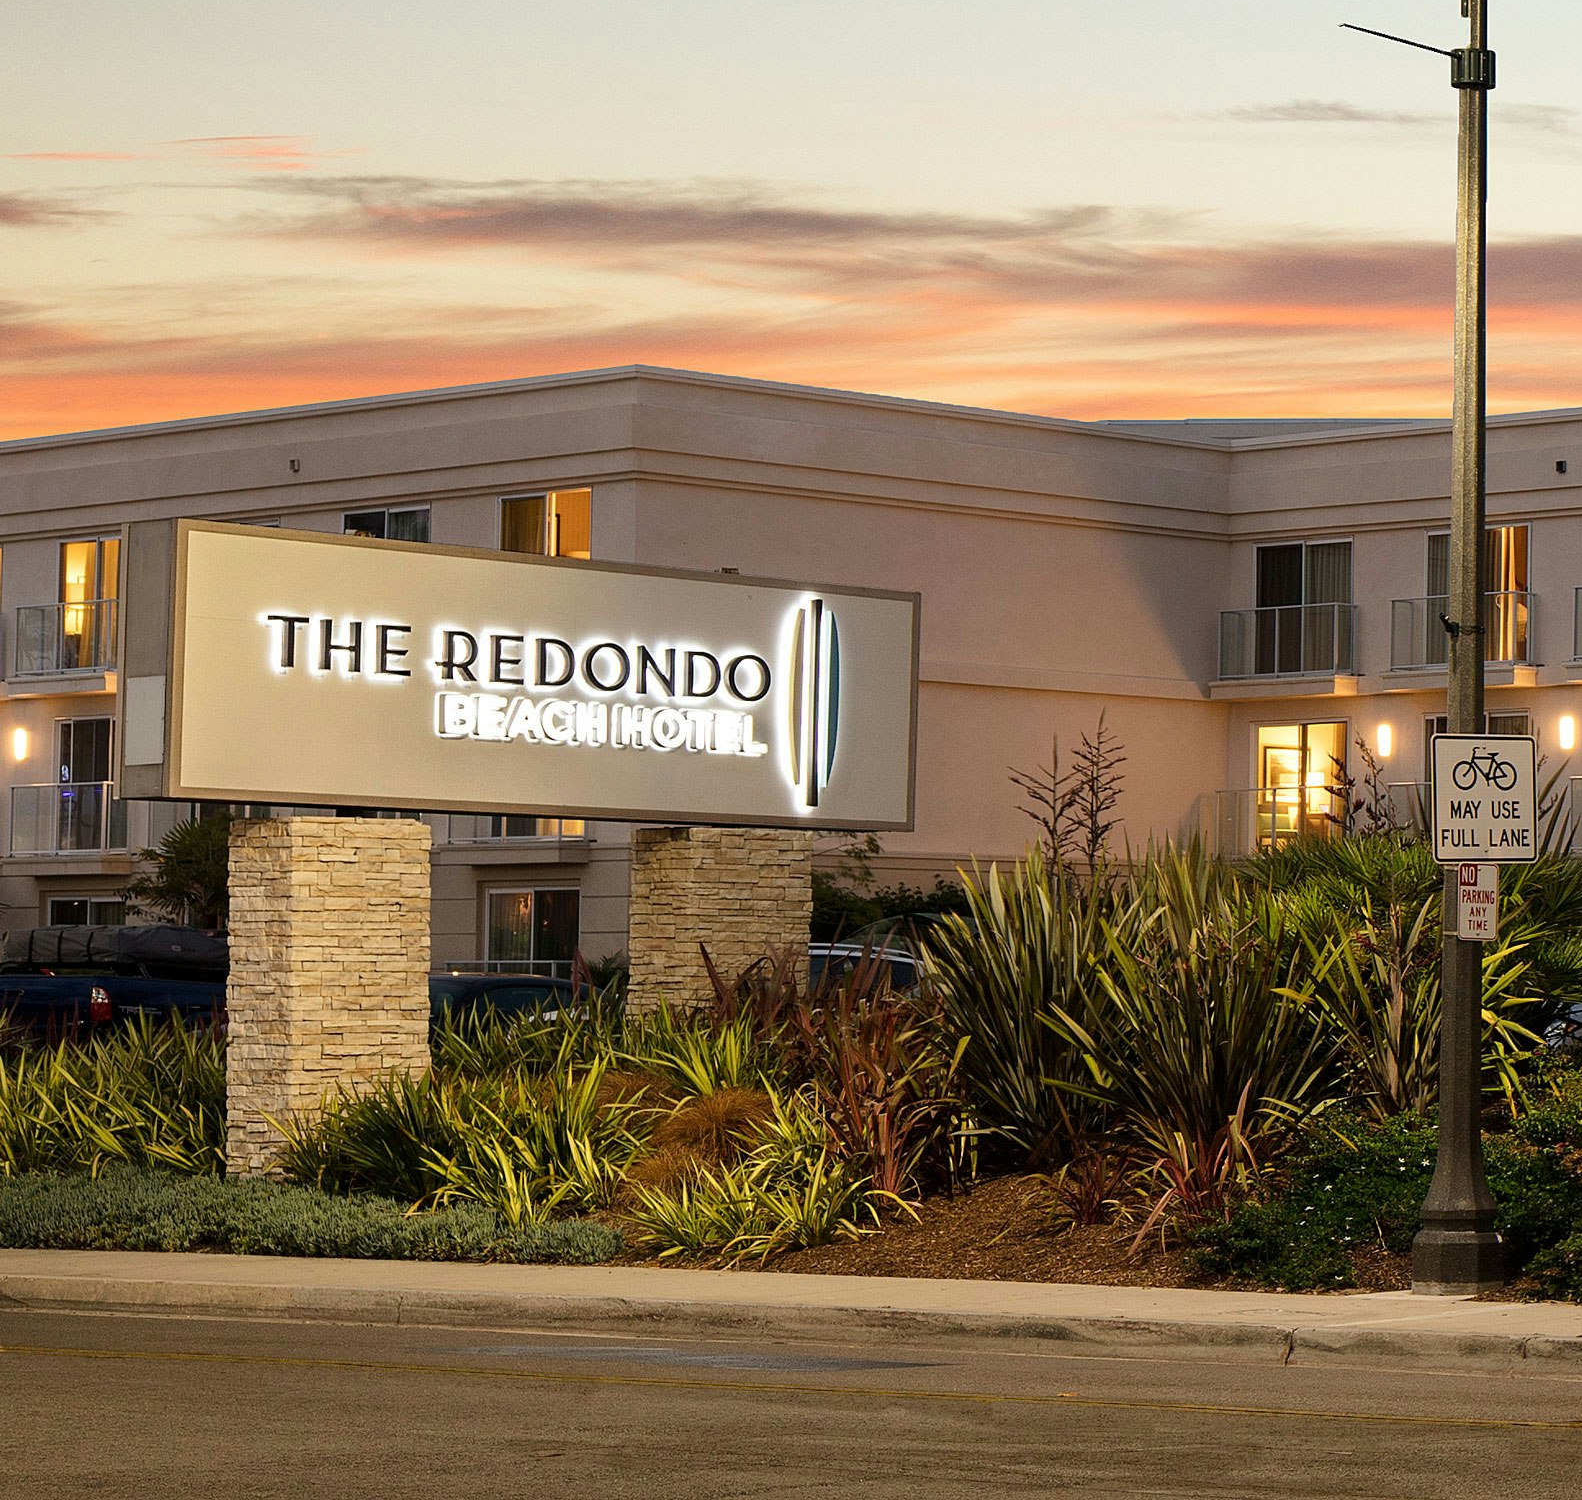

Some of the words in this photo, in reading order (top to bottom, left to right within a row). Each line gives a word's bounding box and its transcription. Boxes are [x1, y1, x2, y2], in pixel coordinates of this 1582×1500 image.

[267, 614, 412, 677] THE
[434, 629, 772, 702] REDONDO
[435, 692, 607, 746] BEACH
[611, 703, 769, 756] HOTEL
[1449, 800, 1482, 819] MAY
[1491, 800, 1521, 819] USE
[1440, 828, 1480, 848] FULL
[1488, 828, 1530, 848] LANE
[1461, 866, 1476, 884] NO
[1462, 889, 1495, 904] PARKING
[1469, 906, 1488, 918] ANY
[1468, 920, 1488, 931] TIME
